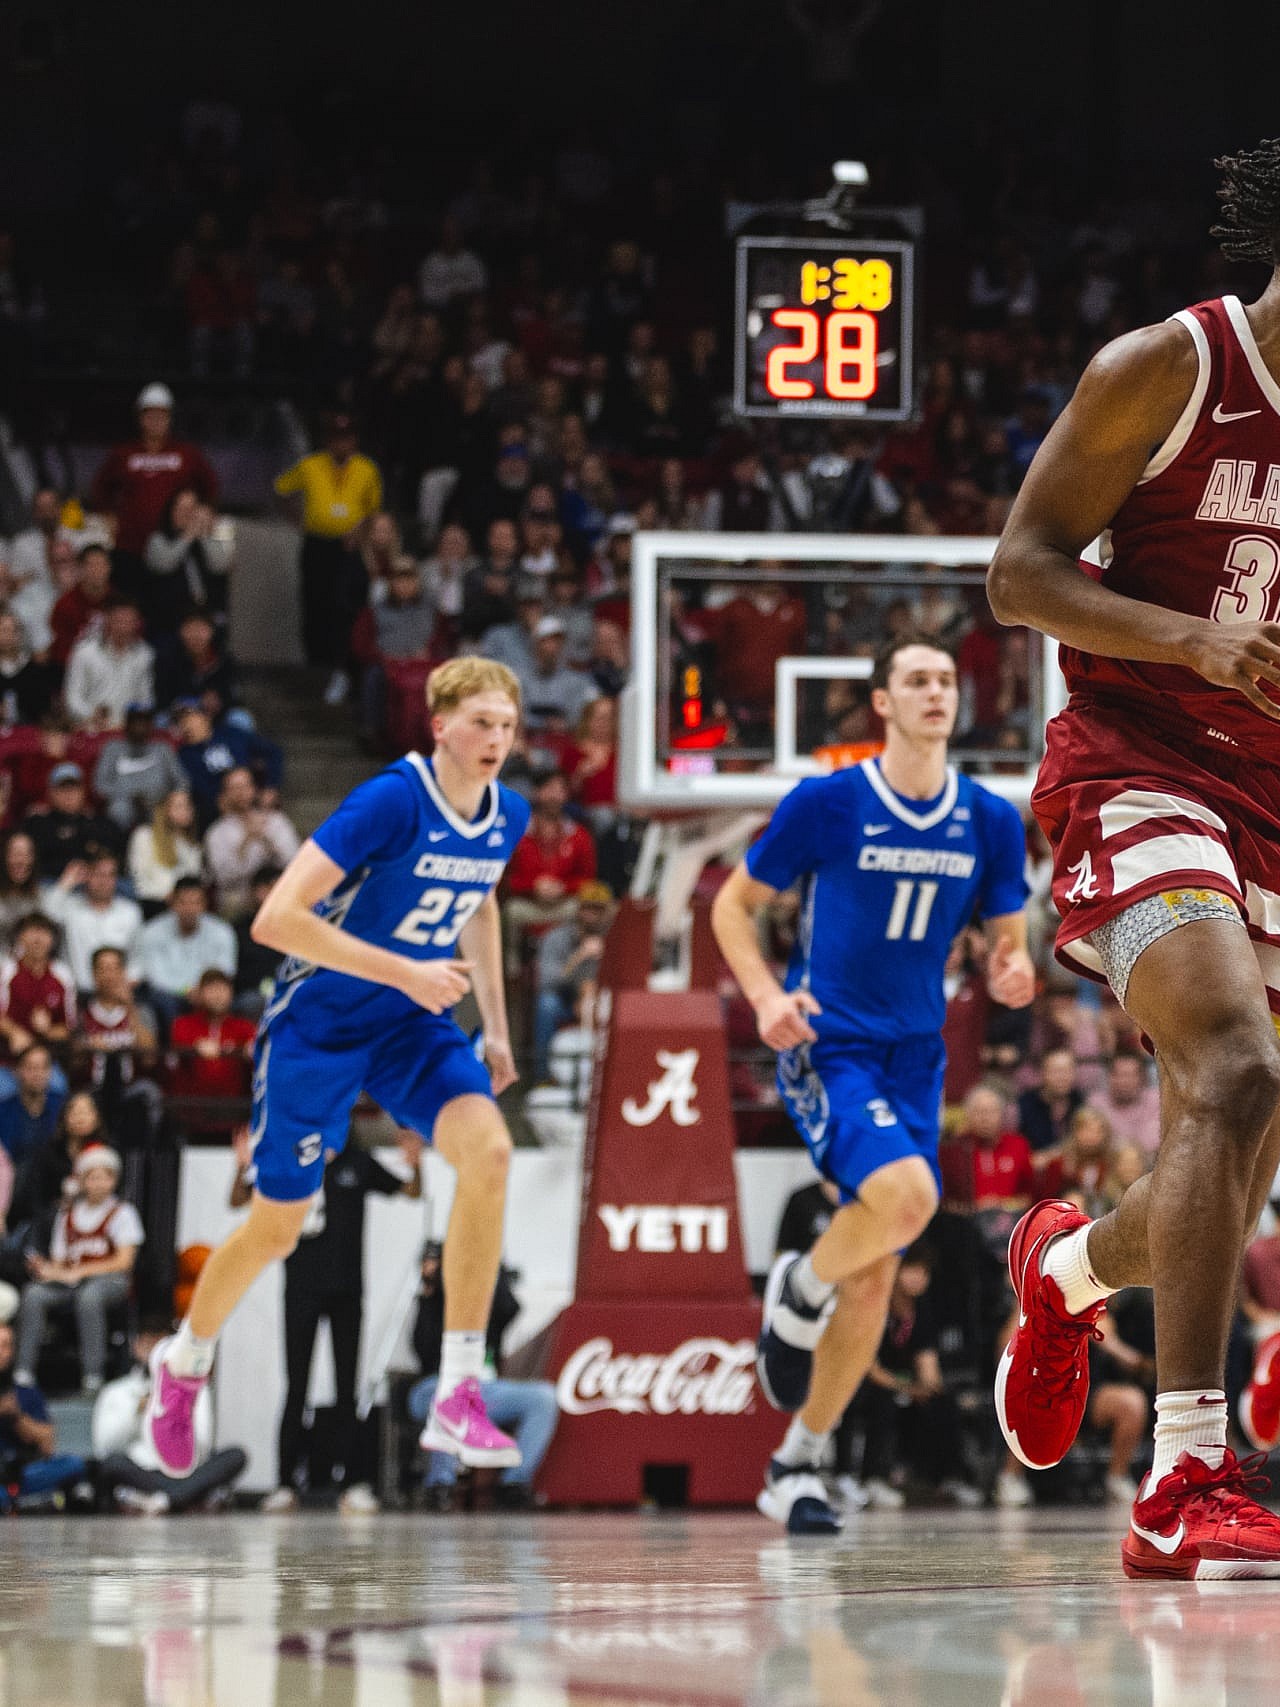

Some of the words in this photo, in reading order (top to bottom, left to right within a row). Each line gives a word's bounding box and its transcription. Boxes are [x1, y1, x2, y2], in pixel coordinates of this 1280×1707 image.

[801, 258, 892, 312] 1:38
[766, 309, 879, 399] 28
[413, 852, 506, 885] CREIGHTO
[857, 844, 976, 879] CREIGHTON
[391, 887, 485, 946] 23
[885, 879, 939, 941] 11
[597, 1204, 728, 1253] YETI
